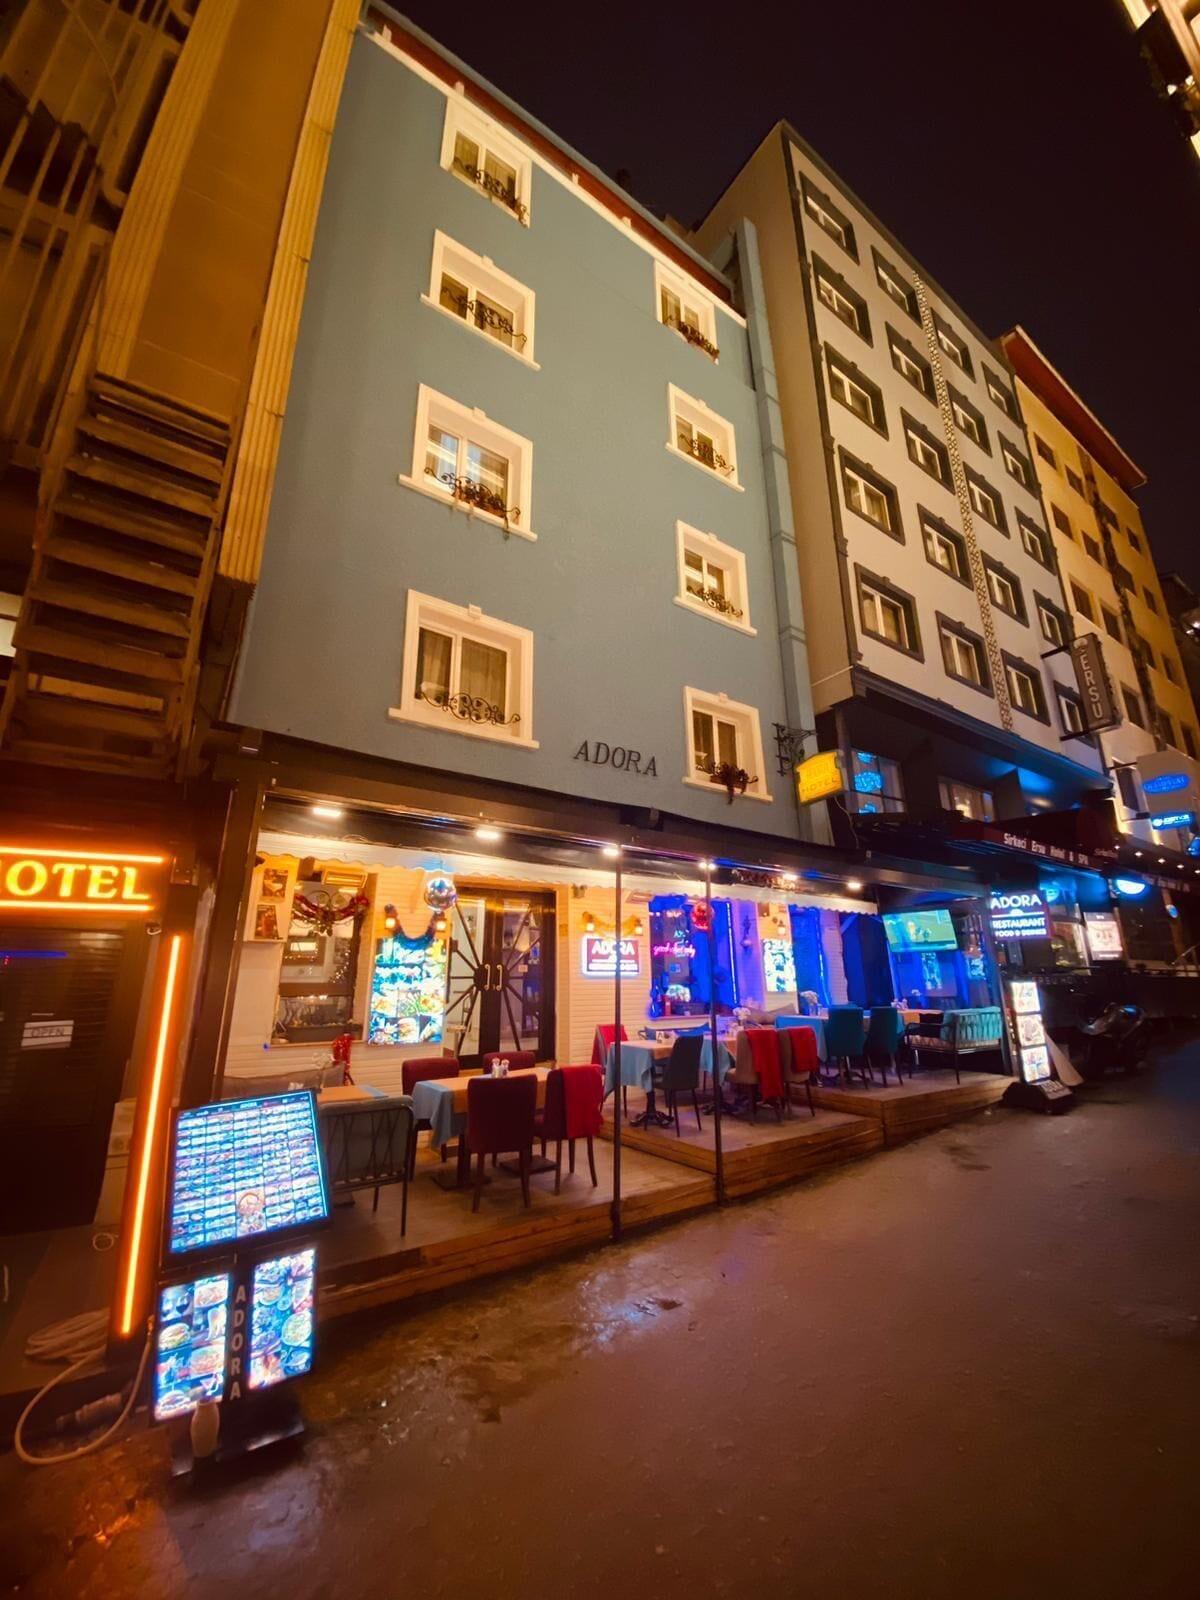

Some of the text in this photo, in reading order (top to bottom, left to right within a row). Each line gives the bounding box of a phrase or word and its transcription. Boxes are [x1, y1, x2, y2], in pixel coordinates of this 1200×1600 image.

[1080, 653, 1103, 719] ERSU
[573, 740, 658, 777] ADORA
[0, 859, 150, 900] OTEL
[991, 894, 1042, 909] ADORA
[992, 918, 1045, 929] RESTAURANT
[229, 1285, 246, 1400] ADORA
